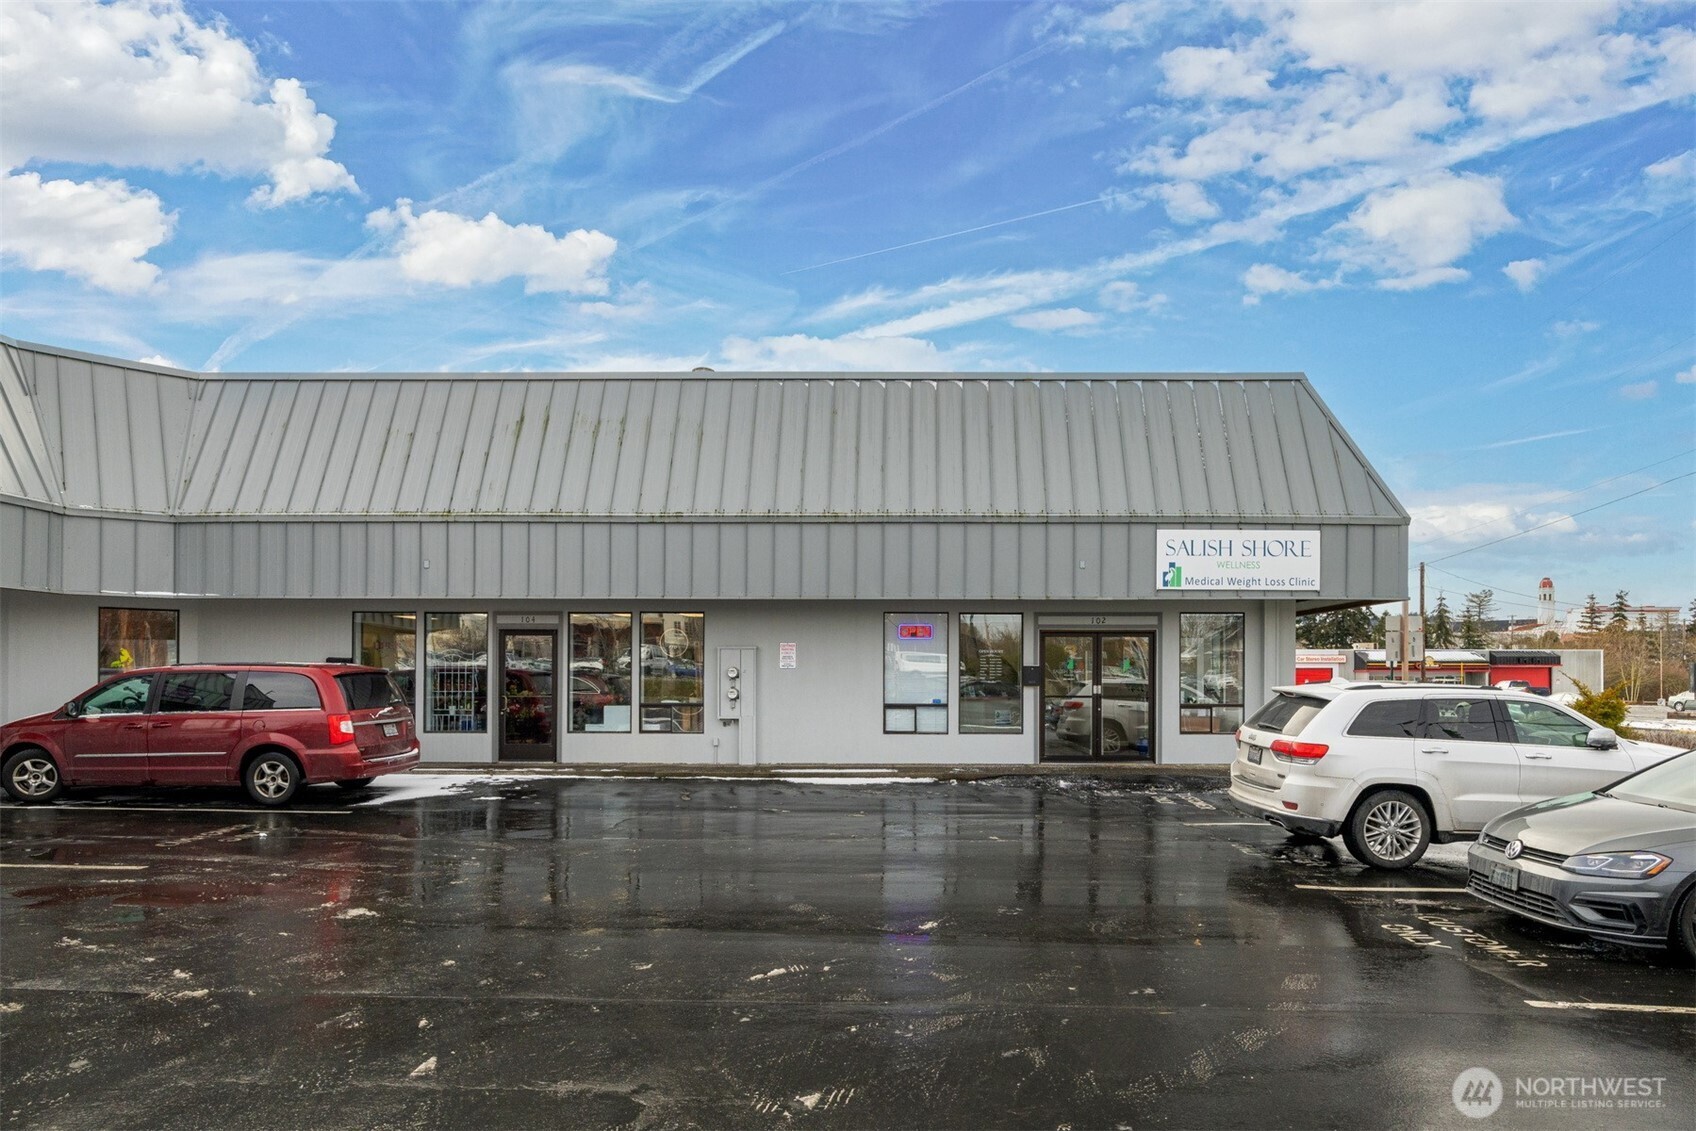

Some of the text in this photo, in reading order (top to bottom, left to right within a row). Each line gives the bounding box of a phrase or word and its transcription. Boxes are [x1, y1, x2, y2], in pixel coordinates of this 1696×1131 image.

[1165, 539, 1312, 557] SALISH SHORE
[1216, 560, 1261, 570] WELLNESS
[1185, 577, 1316, 588] Medical Weight Loss Clinic
[520, 615, 536, 624] 104
[1091, 616, 1107, 625] 102
[900, 626, 931, 638] OPEN
[1381, 923, 1452, 950] ONLY
